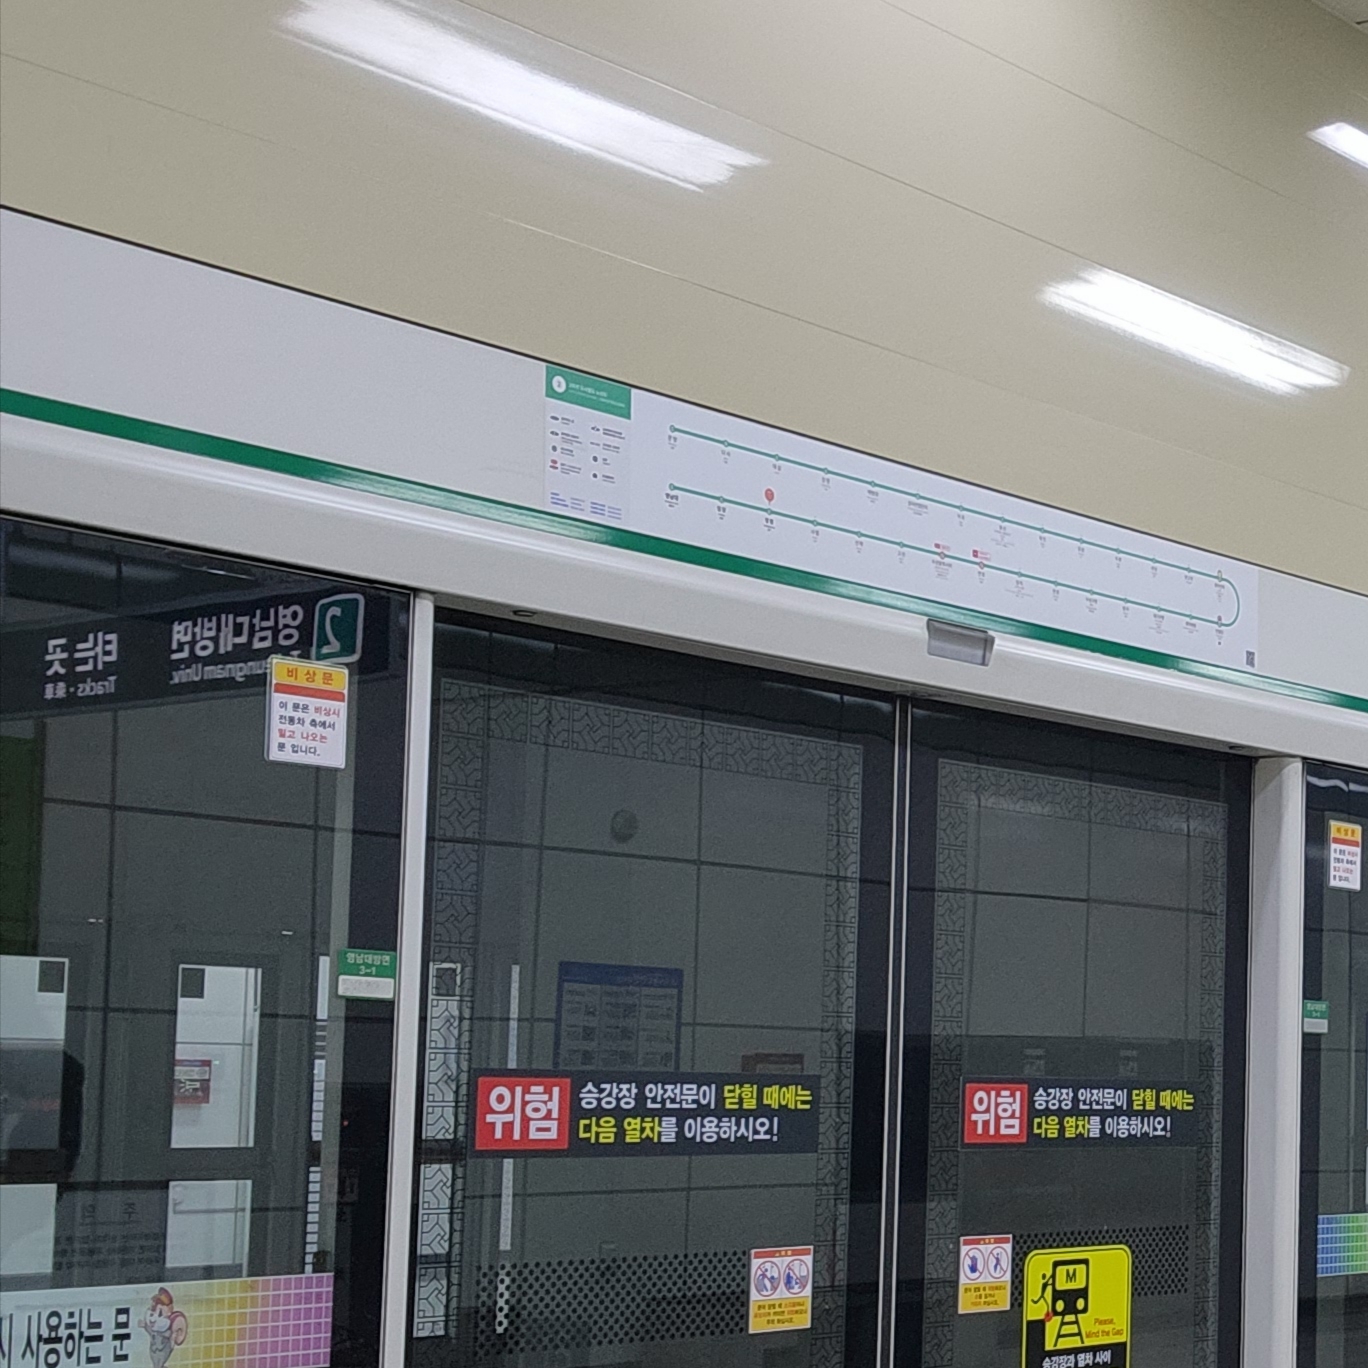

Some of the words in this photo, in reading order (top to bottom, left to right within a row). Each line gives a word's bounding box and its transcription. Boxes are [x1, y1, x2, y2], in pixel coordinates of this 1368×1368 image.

[277, 701, 289, 712] 이
[313, 704, 341, 718] 비상시
[300, 731, 328, 744] 나오는
[359, 965, 377, 976] 3-1
[578, 1082, 637, 1110] 승강장
[643, 1083, 717, 1110] 안전문이
[722, 1084, 758, 1111] 닫힐
[762, 1084, 814, 1111] 때에는
[1032, 1086, 1074, 1111] 승강장
[1077, 1087, 1128, 1111] 안전문이
[1131, 1088, 1156, 1111] 닫힐
[1159, 1088, 1196, 1111] 때에는
[485, 1085, 561, 1141] 위험
[971, 1089, 1022, 1136] 위험
[578, 1115, 617, 1143] 다음
[623, 1115, 679, 1144] 열차를
[684, 1116, 780, 1143] 이용하시오!
[1032, 1115, 1060, 1139] 다음
[1063, 1115, 1101, 1139] 열차를
[1104, 1115, 1172, 1139] 이용하시오!
[1065, 1267, 1078, 1285] M
[112, 1306, 132, 1363] 문
[1094, 1349, 1112, 1366] 사이
